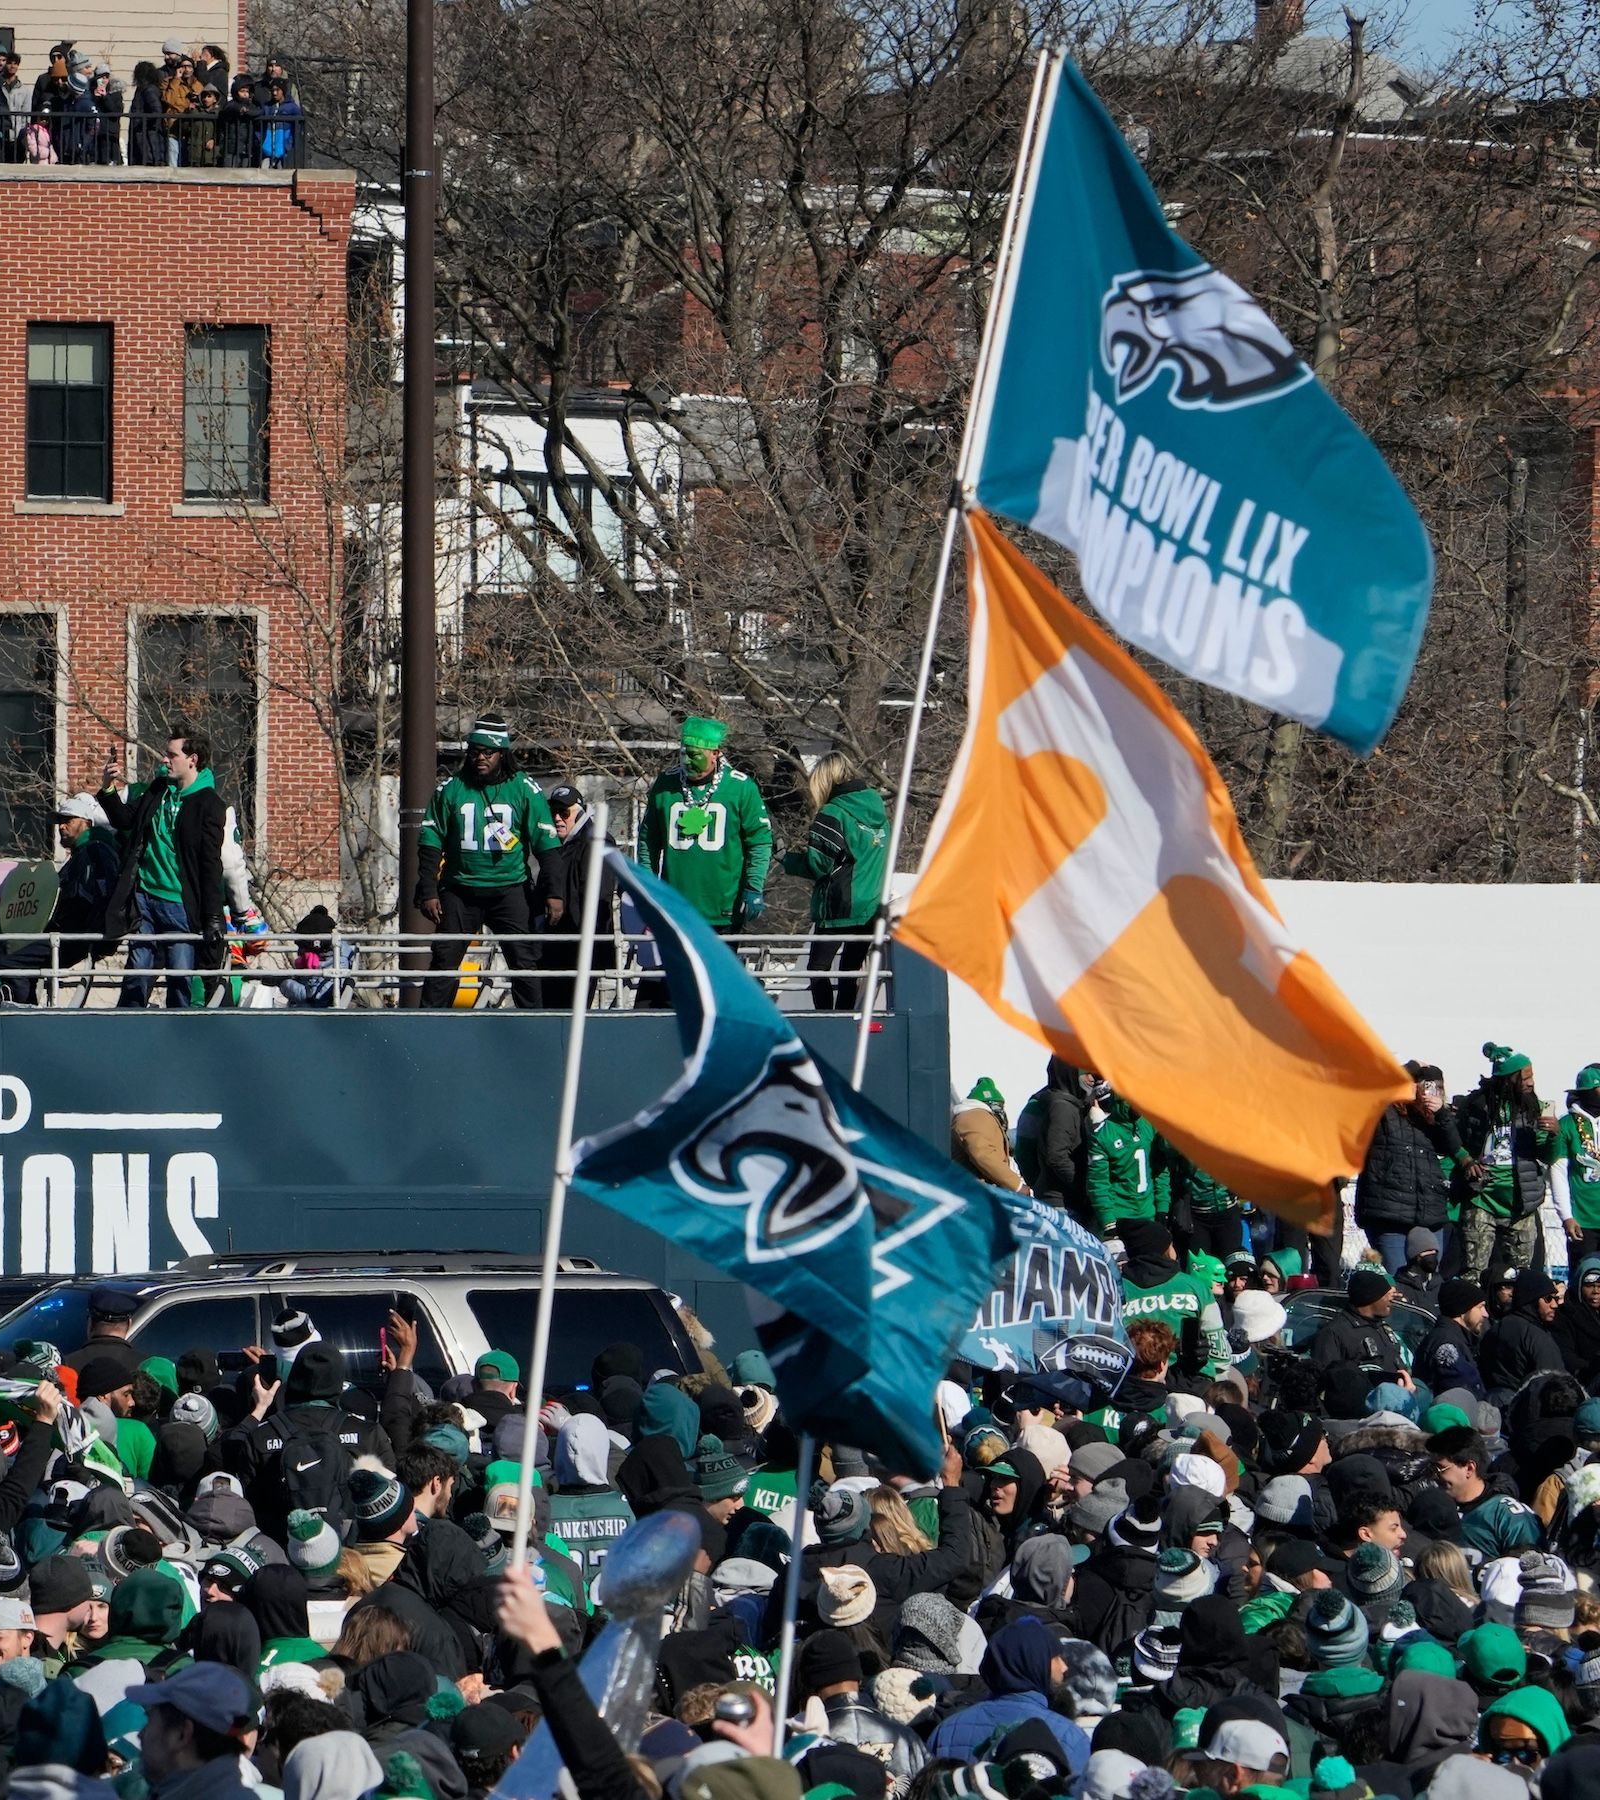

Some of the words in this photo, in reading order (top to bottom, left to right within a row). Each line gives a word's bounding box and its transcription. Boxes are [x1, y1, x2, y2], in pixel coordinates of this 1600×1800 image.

[1086, 388, 1127, 490] PER
[1121, 437, 1223, 554] BOWL
[1223, 499, 1310, 594] LIX
[459, 802, 514, 851] 12
[18, 882, 36, 899] GO
[6, 899, 40, 920] BIRDS
[1133, 1148, 1148, 1193] 1
[552, 1518, 628, 1541] ANKENSHIP
